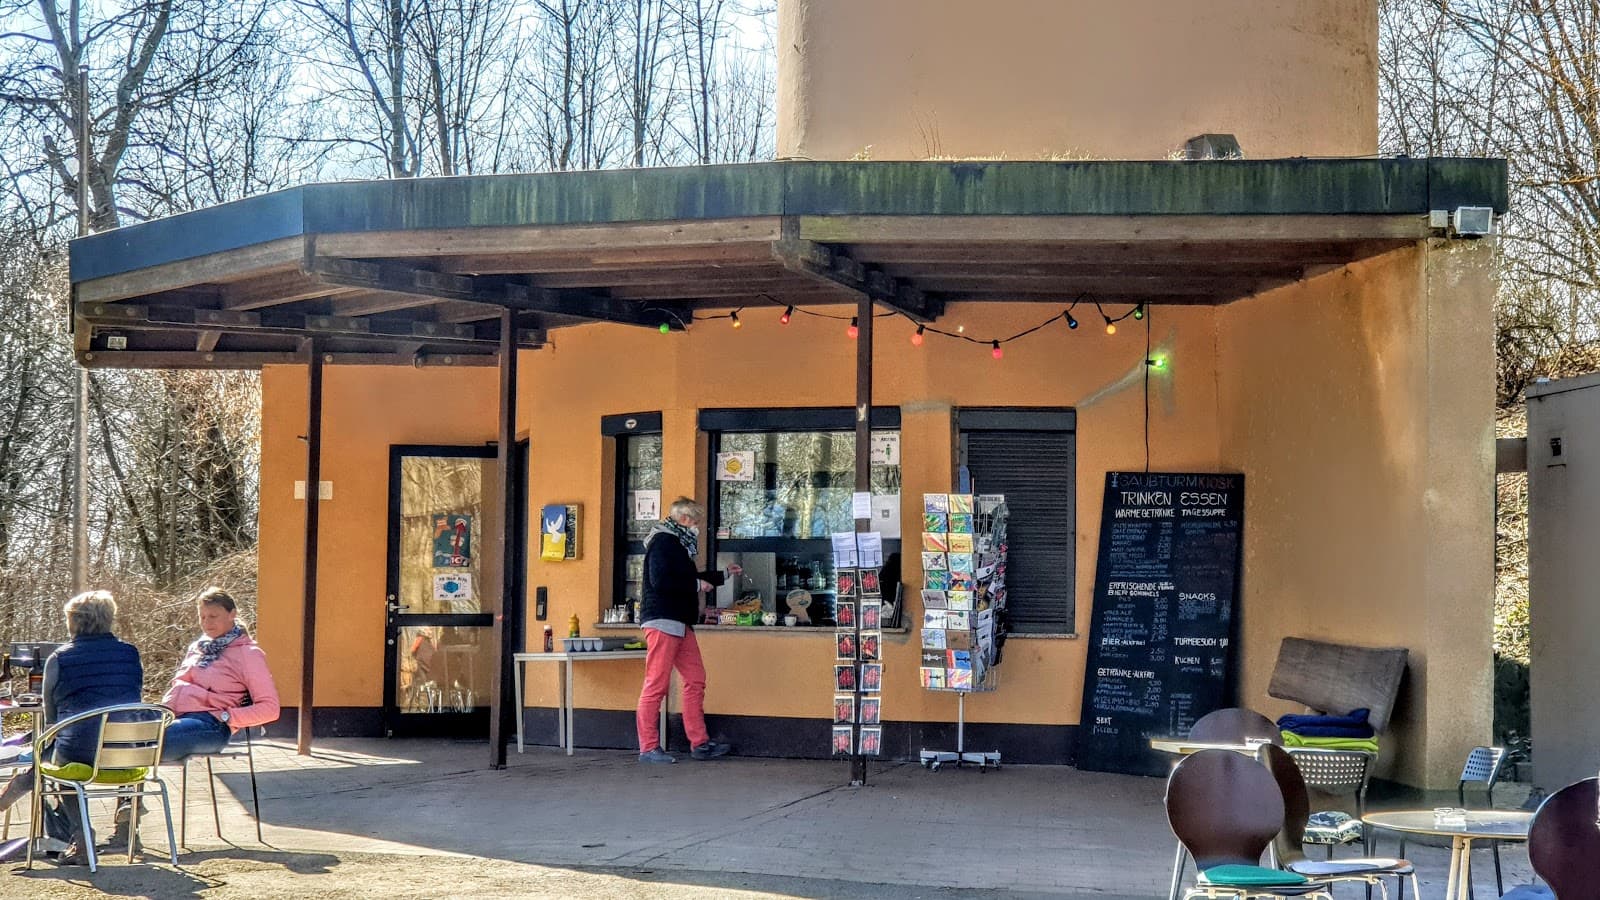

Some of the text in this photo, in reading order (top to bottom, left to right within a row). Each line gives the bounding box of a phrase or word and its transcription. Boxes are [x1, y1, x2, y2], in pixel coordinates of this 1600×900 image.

[1120, 491, 1172, 506] TRINKEN
[1180, 492, 1228, 506] ESSEN
[1181, 508, 1226, 517] TAGESSUPPE
[1178, 592, 1216, 601] SNACKS
[1174, 637, 1216, 647] TURMBESUCH
[1174, 656, 1200, 665] KUCHEN
